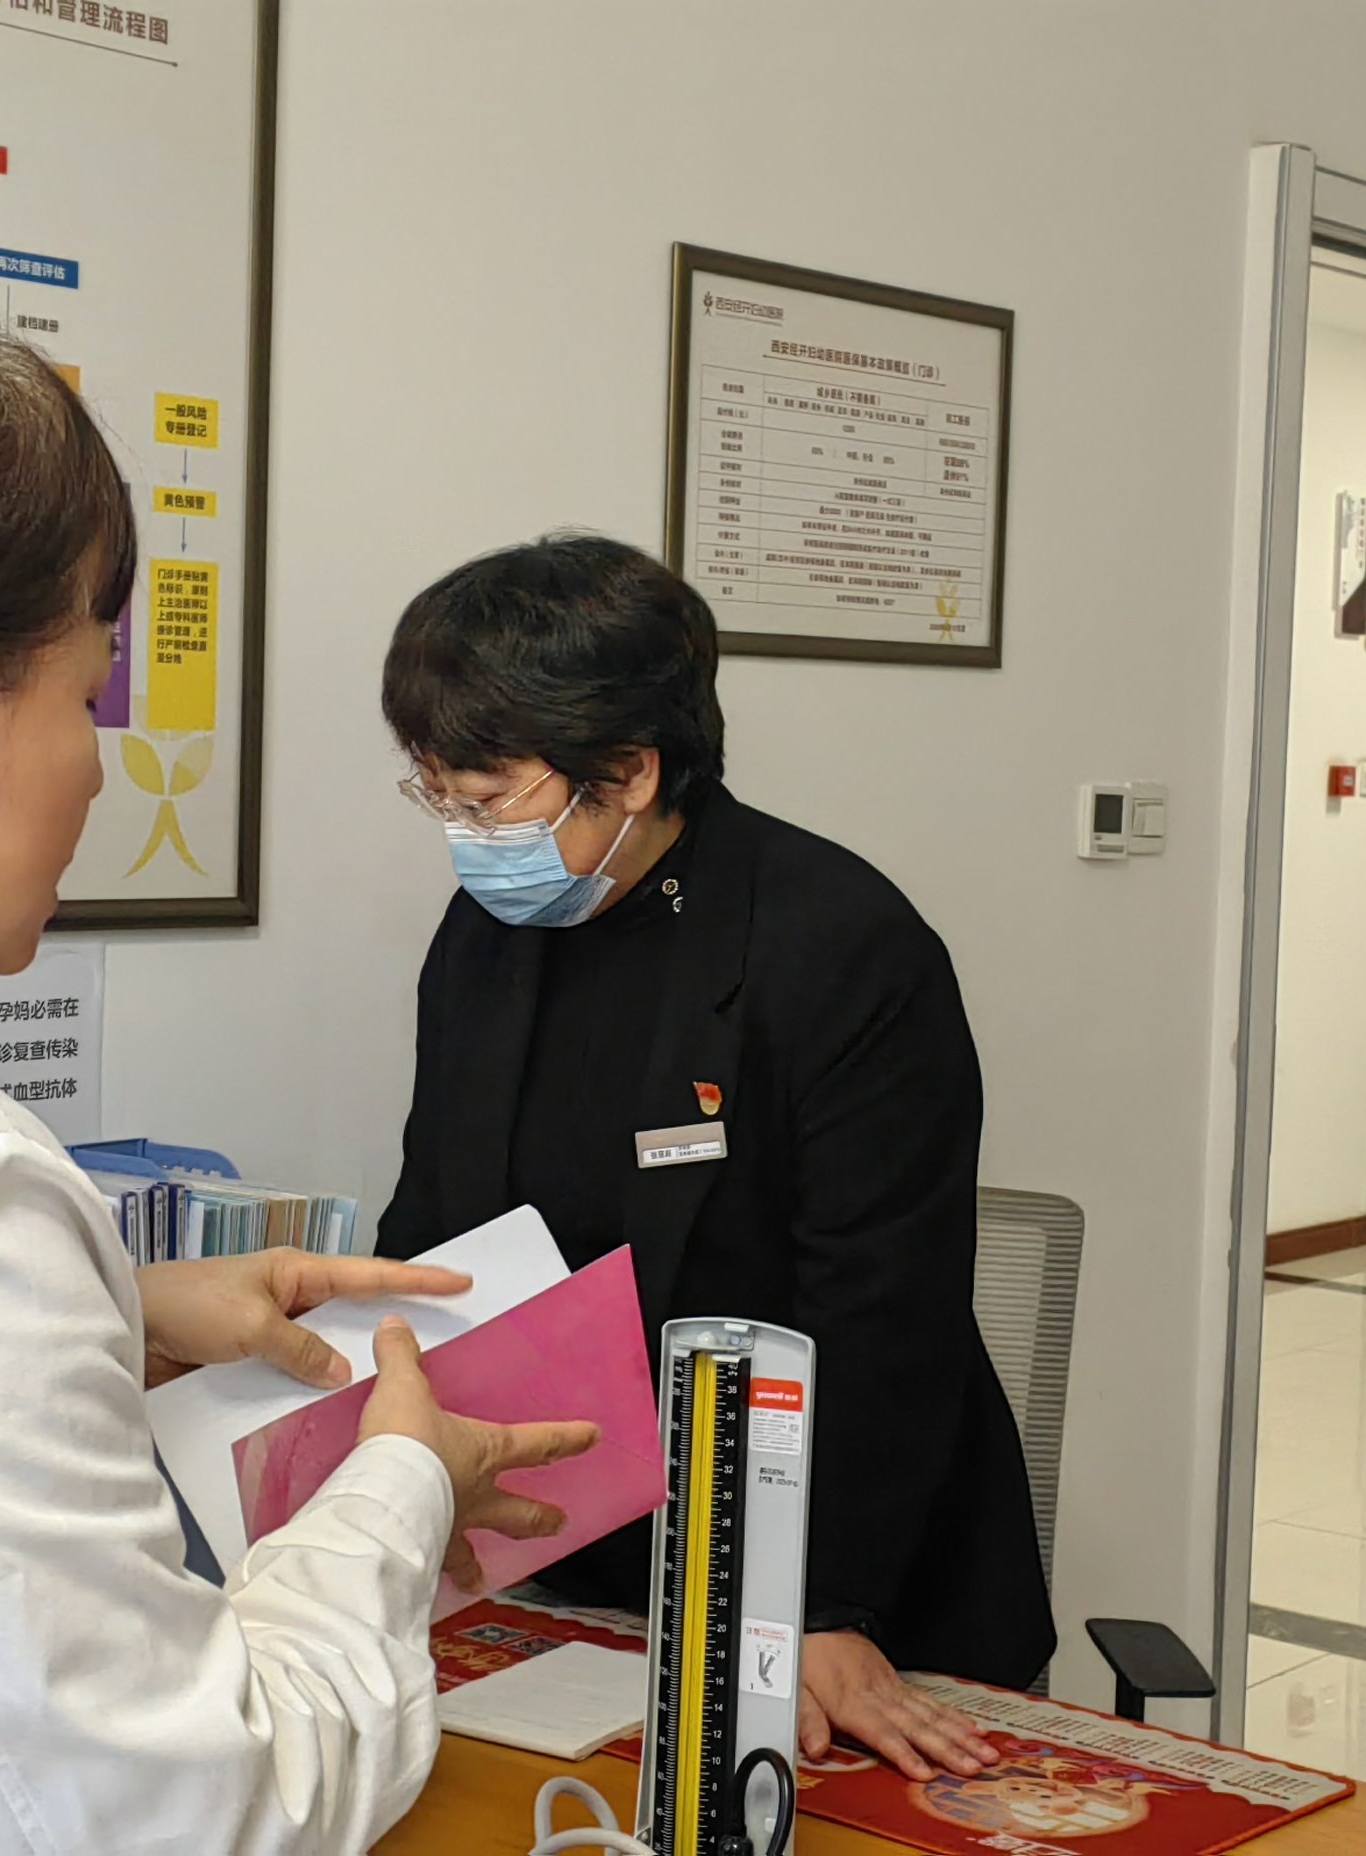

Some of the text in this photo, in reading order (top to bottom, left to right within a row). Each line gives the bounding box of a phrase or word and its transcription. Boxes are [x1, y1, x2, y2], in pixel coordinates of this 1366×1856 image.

[727, 1386, 737, 1394] 38
[726, 1412, 736, 1420] 36
[725, 1439, 734, 1447] 34
[724, 1465, 734, 1474] 32
[723, 1491, 732, 1500] 30
[721, 1518, 731, 1527] 28
[719, 1571, 729, 1579] 24
[718, 1598, 728, 1606] 22
[716, 1624, 726, 1633] 20
[716, 1651, 725, 1659] 18
[715, 1677, 724, 1686] 16
[714, 1704, 723, 1712] 14
[713, 1730, 722, 1738] 12
[712, 1756, 721, 1765] 10
[712, 1783, 717, 1791] 8
[711, 1809, 716, 1817] 6
[709, 1836, 715, 1844] 4
